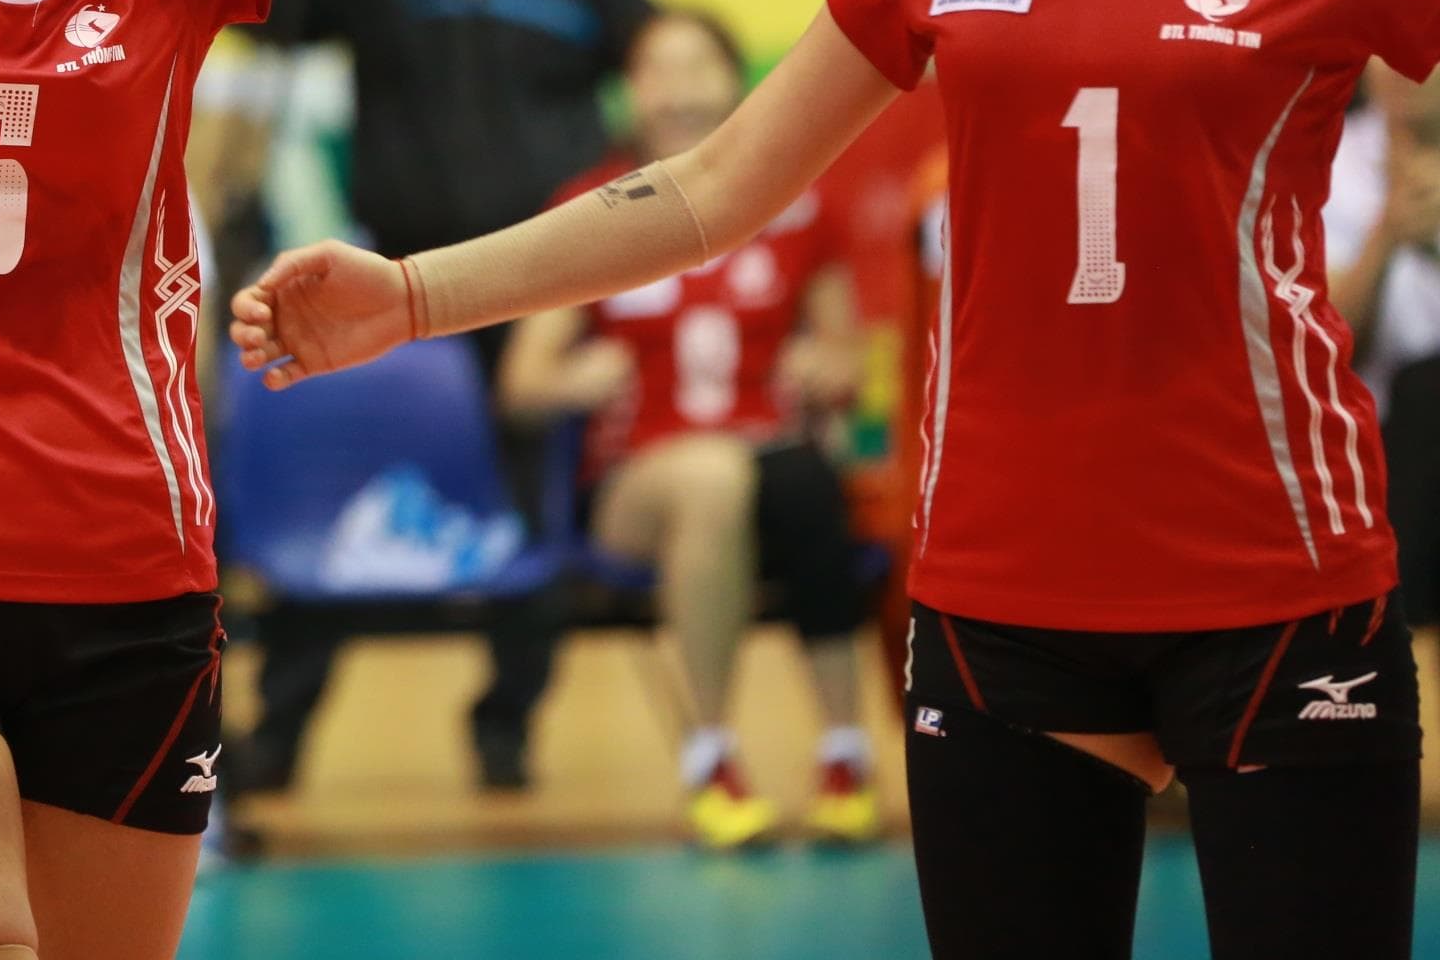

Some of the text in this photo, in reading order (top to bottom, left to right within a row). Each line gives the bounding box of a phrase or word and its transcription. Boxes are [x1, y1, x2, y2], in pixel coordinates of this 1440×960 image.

[1187, 22, 1235, 46] THÔNG
[1236, 29, 1262, 49] TIN
[56, 60, 80, 73] BTL
[1060, 87, 1126, 305] 1
